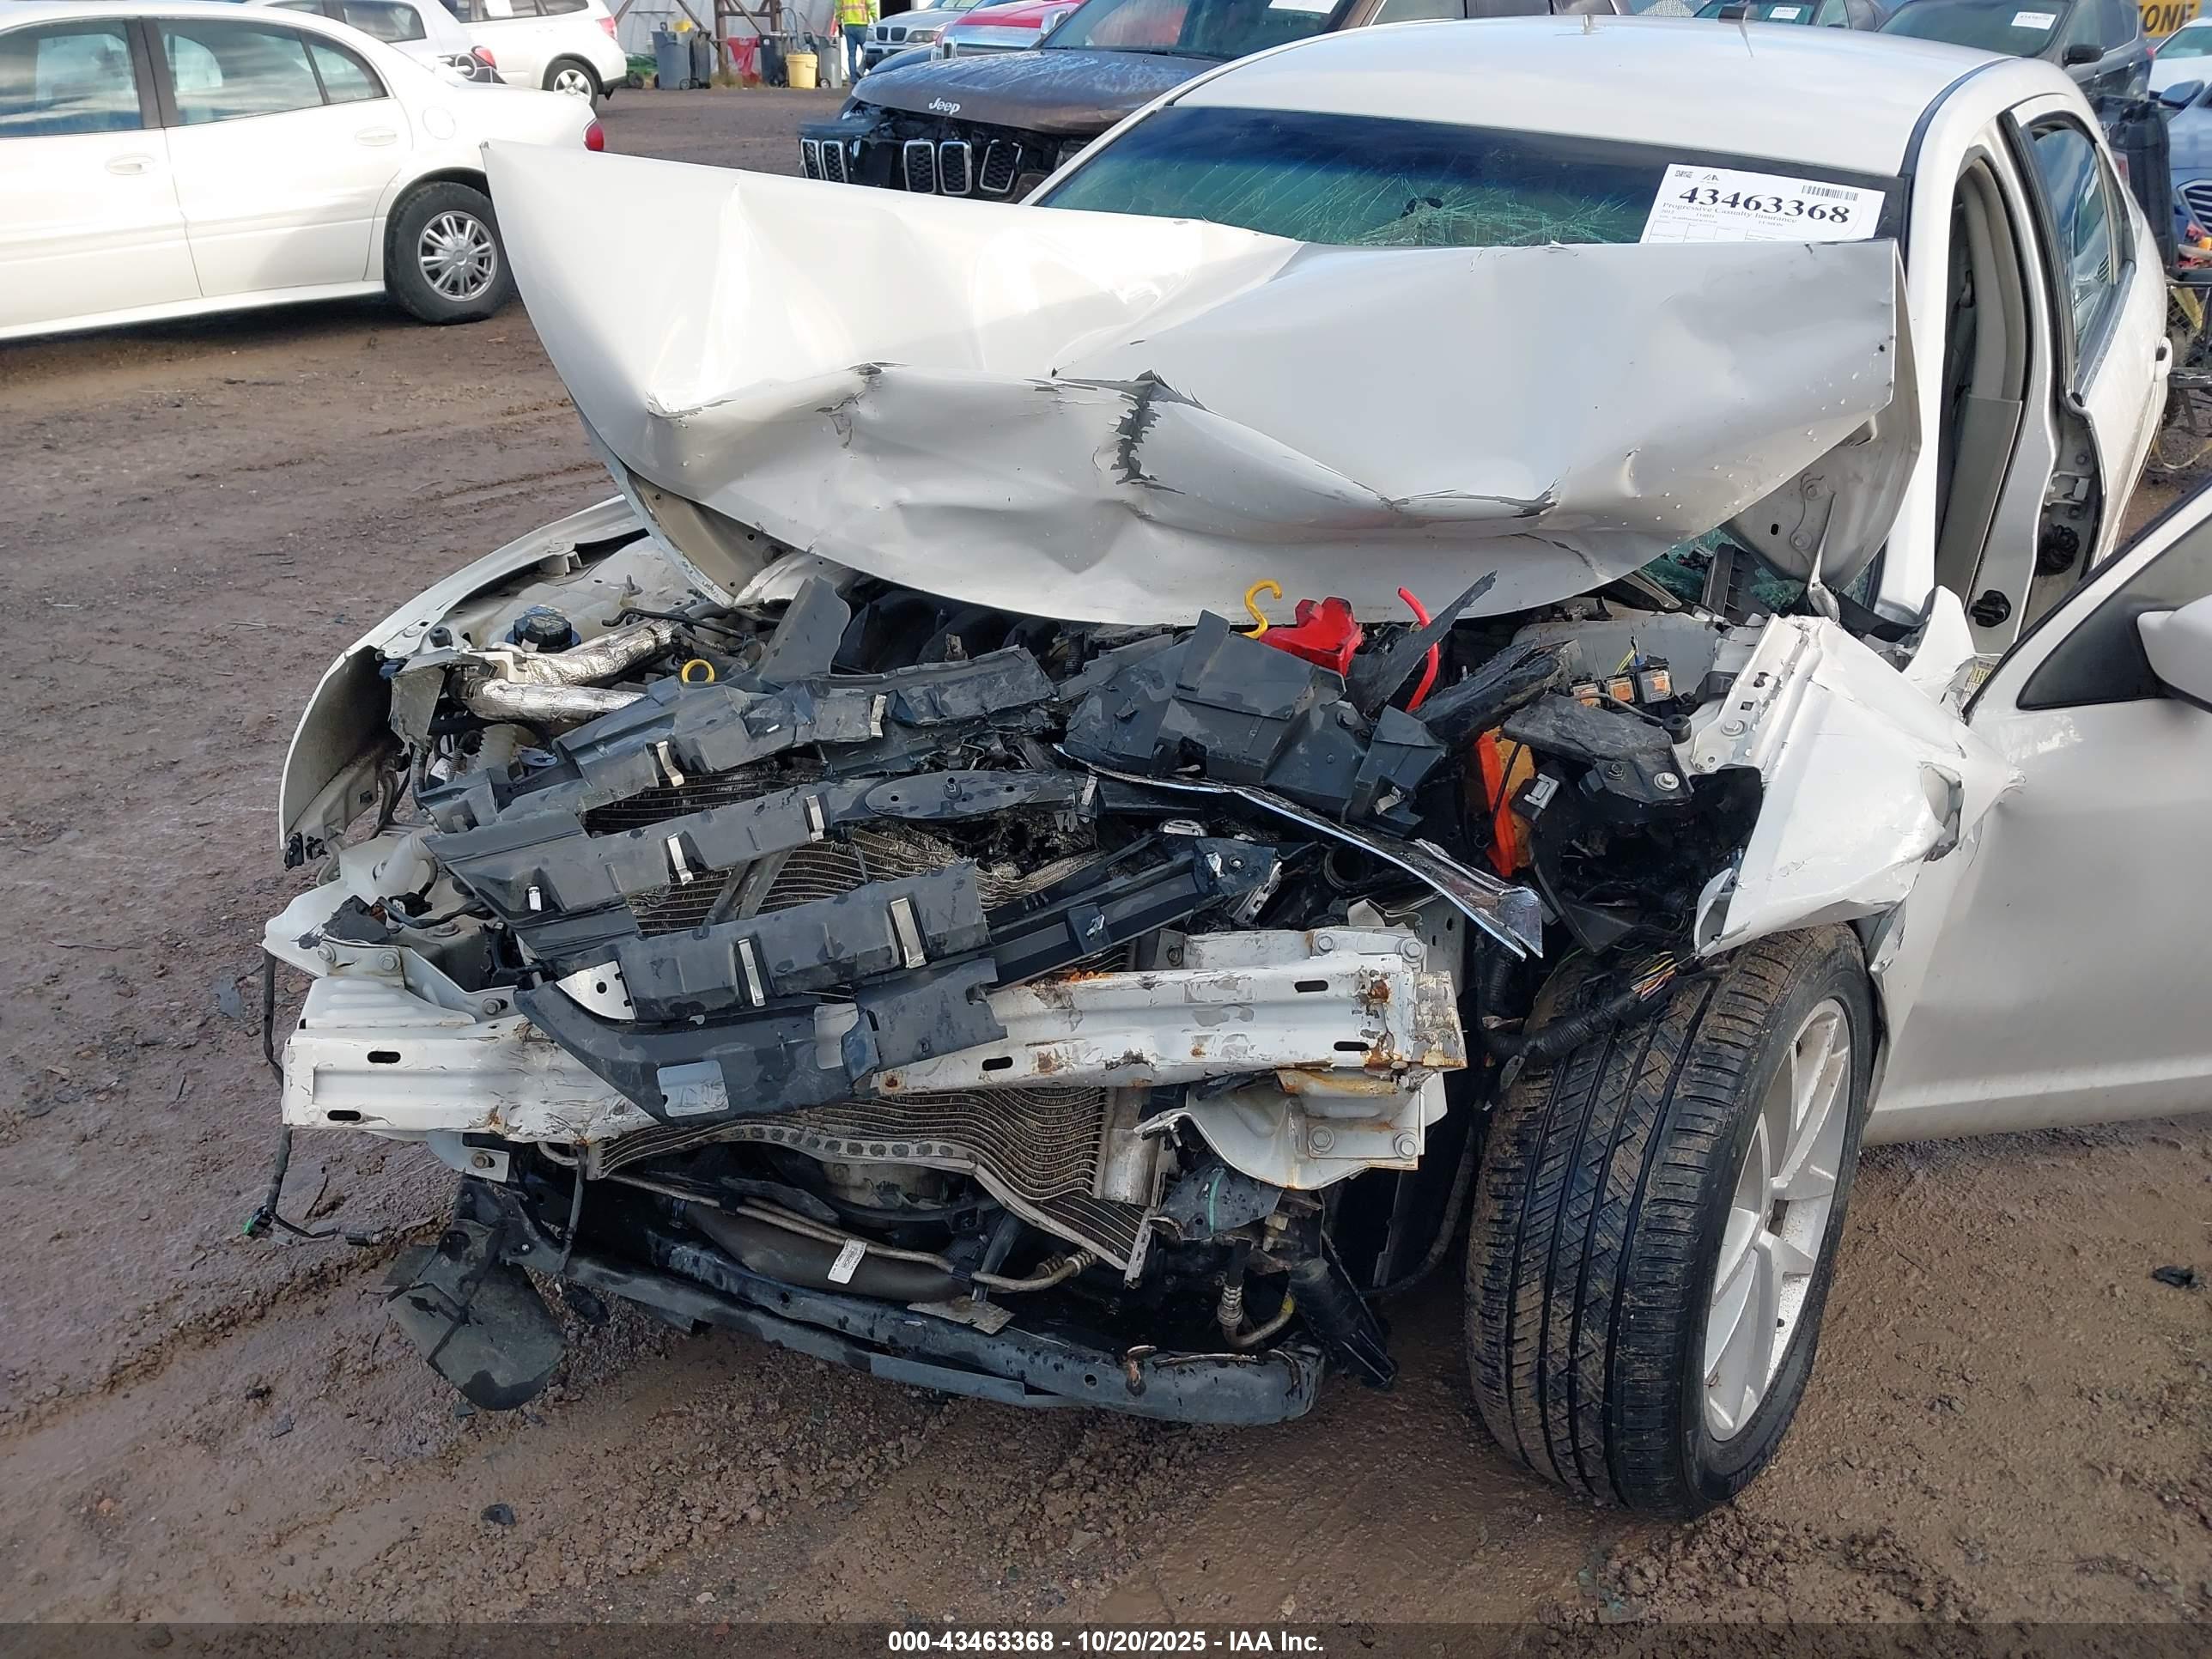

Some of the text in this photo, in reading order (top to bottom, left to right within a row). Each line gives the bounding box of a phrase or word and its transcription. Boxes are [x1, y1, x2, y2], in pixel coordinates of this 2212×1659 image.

[928, 96, 961, 116] Jeep
[1662, 202, 1714, 213] Progressive
[1754, 212, 1798, 224] Insurance
[1679, 186, 1850, 224] 43463368
